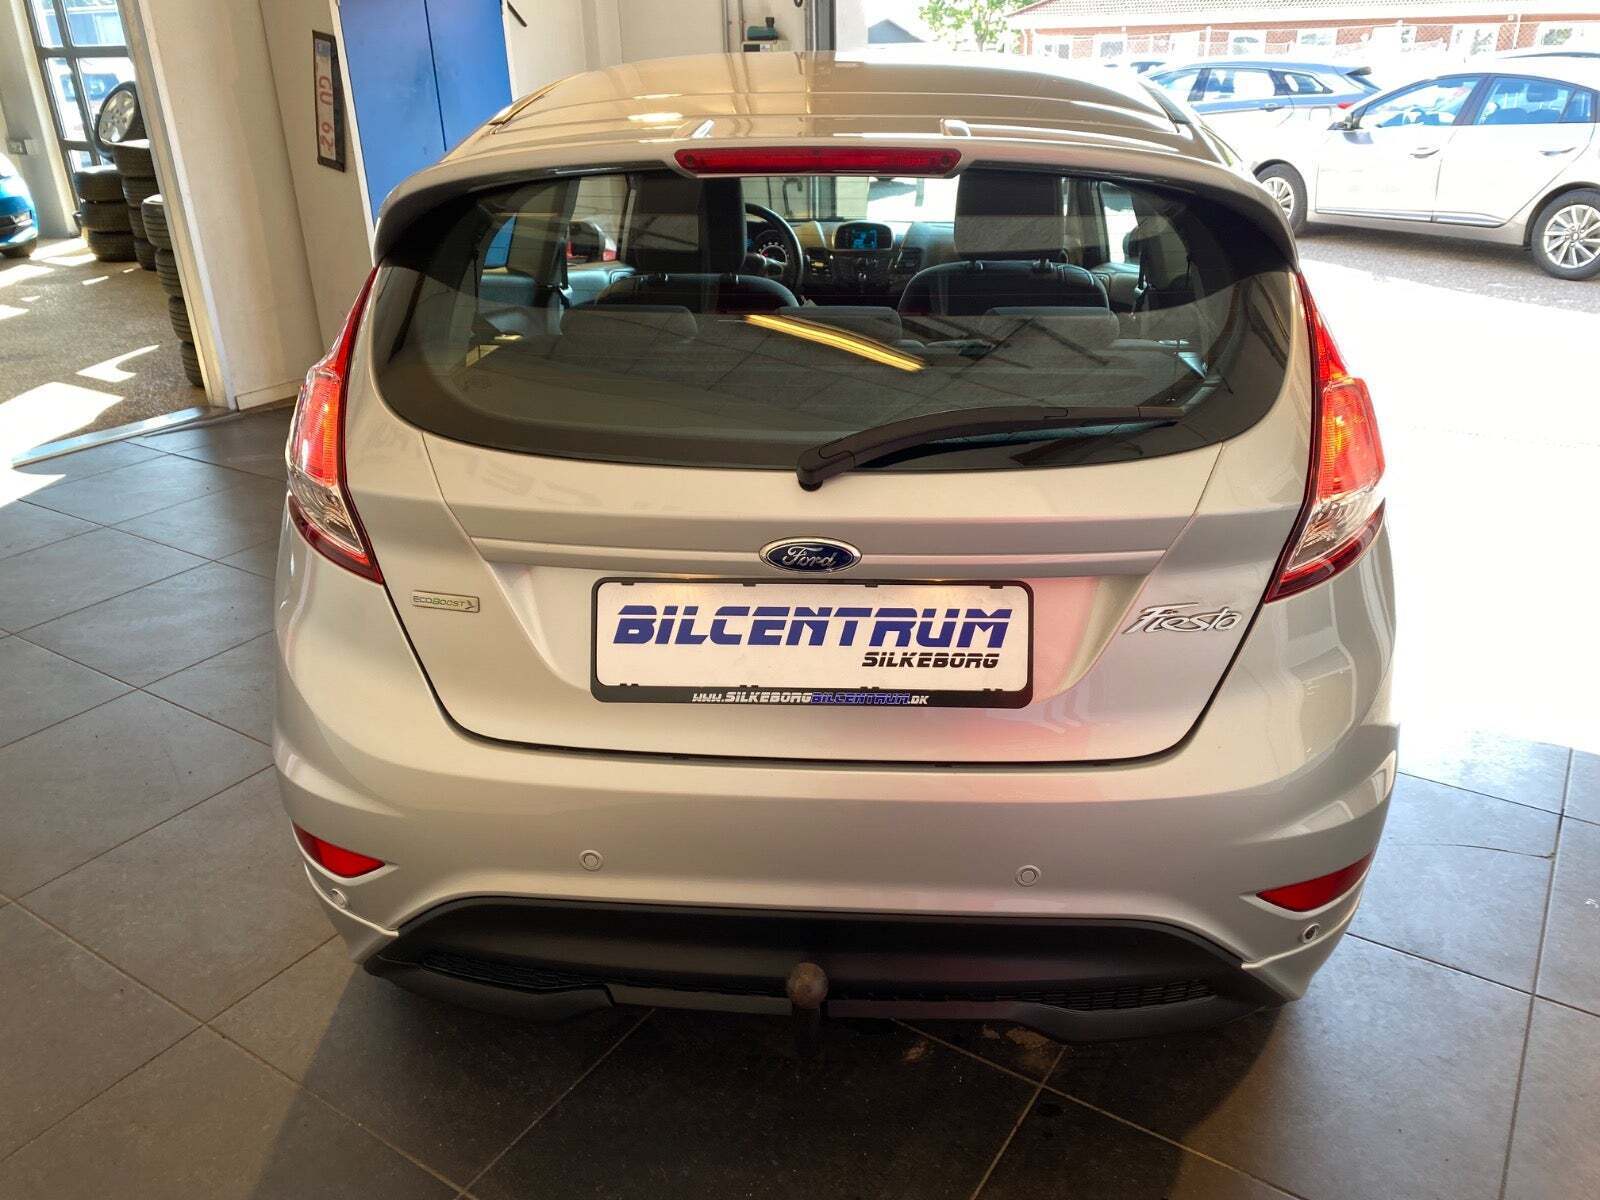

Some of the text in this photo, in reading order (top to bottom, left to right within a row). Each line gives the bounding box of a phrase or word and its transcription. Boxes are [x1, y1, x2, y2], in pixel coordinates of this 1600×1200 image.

[782, 545, 837, 567] Ford
[613, 604, 1012, 649] BILCENTRUM
[1121, 601, 1242, 634] Fiesta
[861, 651, 1000, 669] SILKEBORG
